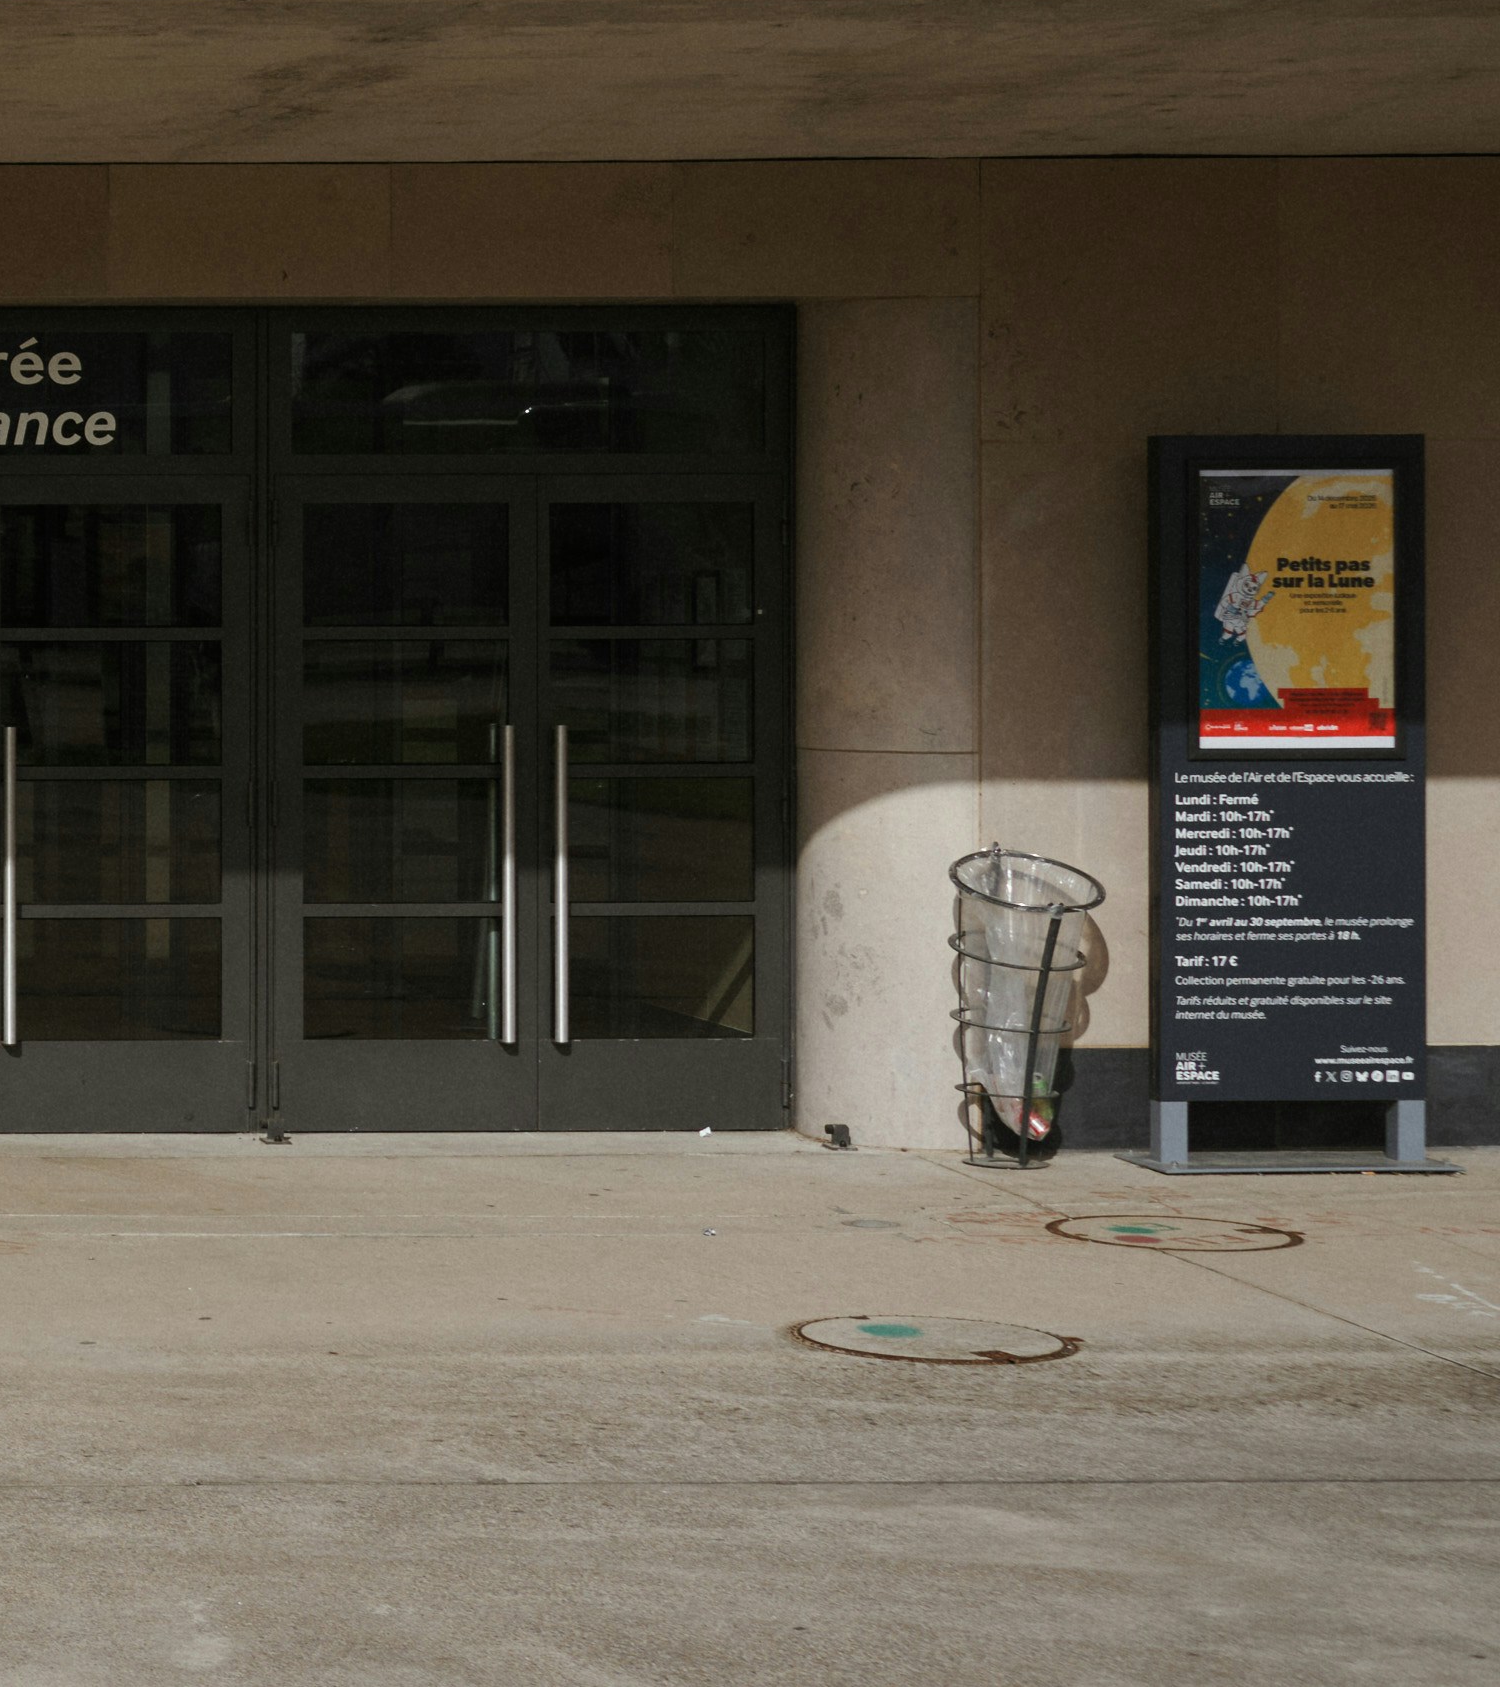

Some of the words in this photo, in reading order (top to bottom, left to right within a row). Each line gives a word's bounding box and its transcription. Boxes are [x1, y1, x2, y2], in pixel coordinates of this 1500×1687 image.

[1276, 556, 1332, 572] Petits
[1335, 559, 1371, 575] pas
[1272, 576, 1304, 588] sur
[1307, 573, 1325, 588] la
[1328, 573, 1375, 588] Lune
[1175, 772, 1189, 784] Le
[1190, 771, 1227, 783] musée
[1228, 772, 1243, 783] de
[1244, 772, 1264, 783] l'Air
[1264, 773, 1277, 783] et
[1277, 772, 1291, 783] de
[1292, 772, 1335, 785] l'Espace
[1336, 773, 1362, 783] vous
[1363, 771, 1410, 783] accueille
[1175, 794, 1211, 805] Lundi
[1219, 793, 1259, 805] Fermé
[1175, 811, 1211, 822] Mardi
[1175, 828, 1231, 839] Mercredi
[1174, 845, 1207, 858] Jeudi
[1175, 862, 1232, 873] Vendredi
[1175, 879, 1223, 890] Samedi
[1175, 895, 1240, 907] Dimanche
[1209, 917, 1233, 927] avril
[1234, 919, 1248, 927] au
[1249, 917, 1264, 927] 30
[1324, 917, 1334, 927] le
[1335, 916, 1369, 927] musée
[1369, 917, 1415, 929] prolonge
[1176, 933, 1192, 942] ses
[1193, 932, 1234, 942] horaires
[1234, 932, 1246, 942] et
[1247, 931, 1277, 942] ferme
[1277, 933, 1294, 942] ses
[1294, 932, 1327, 943] portes
[1328, 931, 1336, 941] à
[1337, 931, 1350, 941] 18
[1175, 956, 1204, 967] Tarif
[1211, 956, 1228, 967] 17
[1229, 956, 1239, 967] €
[1175, 976, 1225, 986] Collection
[1226, 976, 1287, 988] permanente
[1287, 976, 1327, 988] gratuite
[1327, 977, 1351, 987] pour
[1352, 975, 1367, 985] les
[1368, 975, 1385, 985] -26
[1385, 977, 1406, 985] ans.
[1176, 996, 1202, 1006] Tarifs
[1203, 996, 1238, 1006] réduits
[1238, 997, 1249, 1006] et
[1249, 996, 1290, 1008] gratuité
[1290, 996, 1345, 1007] disponibles
[1363, 996, 1374, 1005] le
[1374, 996, 1393, 1005] site
[1175, 1011, 1215, 1020] internet
[1216, 1011, 1230, 1020] du
[1231, 1010, 1267, 1020] musée.
[1340, 1045, 1388, 1054] Suivez-nous
[1176, 1051, 1208, 1061] MUSÉE
[1175, 1061, 1197, 1071] AIR
[1175, 1071, 1220, 1081] ESPACE
